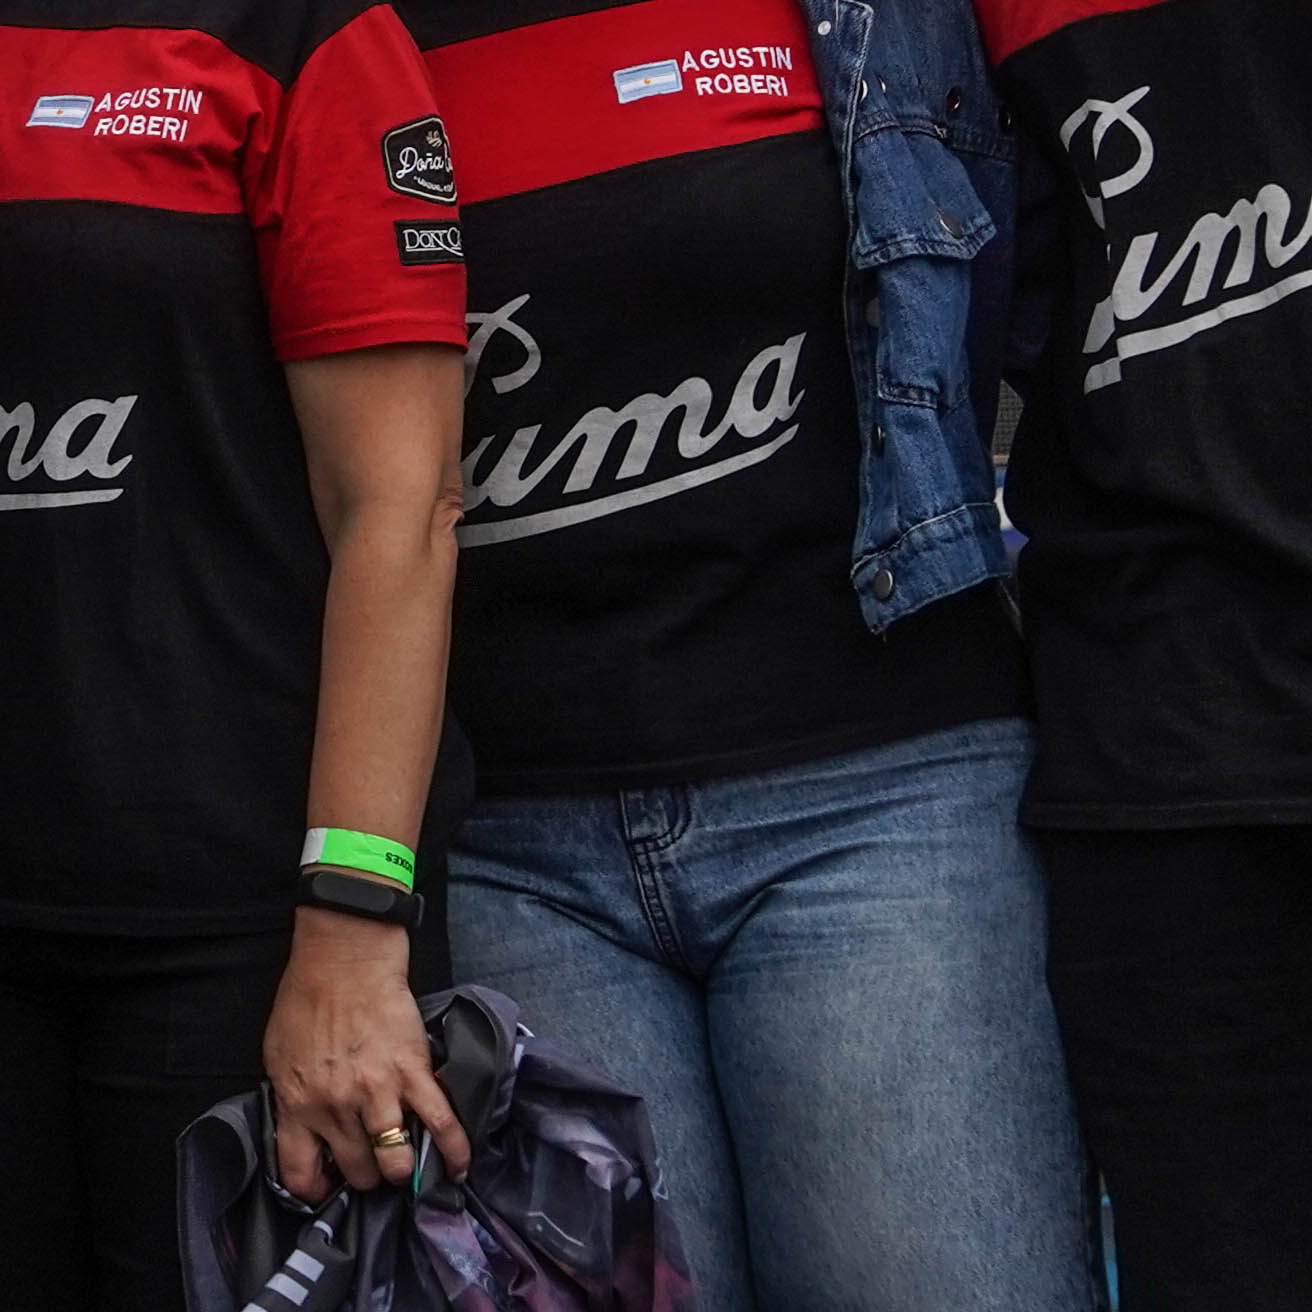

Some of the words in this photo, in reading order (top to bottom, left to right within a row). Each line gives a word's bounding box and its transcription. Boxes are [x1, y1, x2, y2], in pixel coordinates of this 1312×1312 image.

[681, 45, 793, 74] AGUSTIN
[694, 72, 789, 97] ROBERI
[95, 87, 204, 116] AGUSTIN
[93, 115, 189, 143] ROBERI
[1059, 85, 1312, 356] Pum
